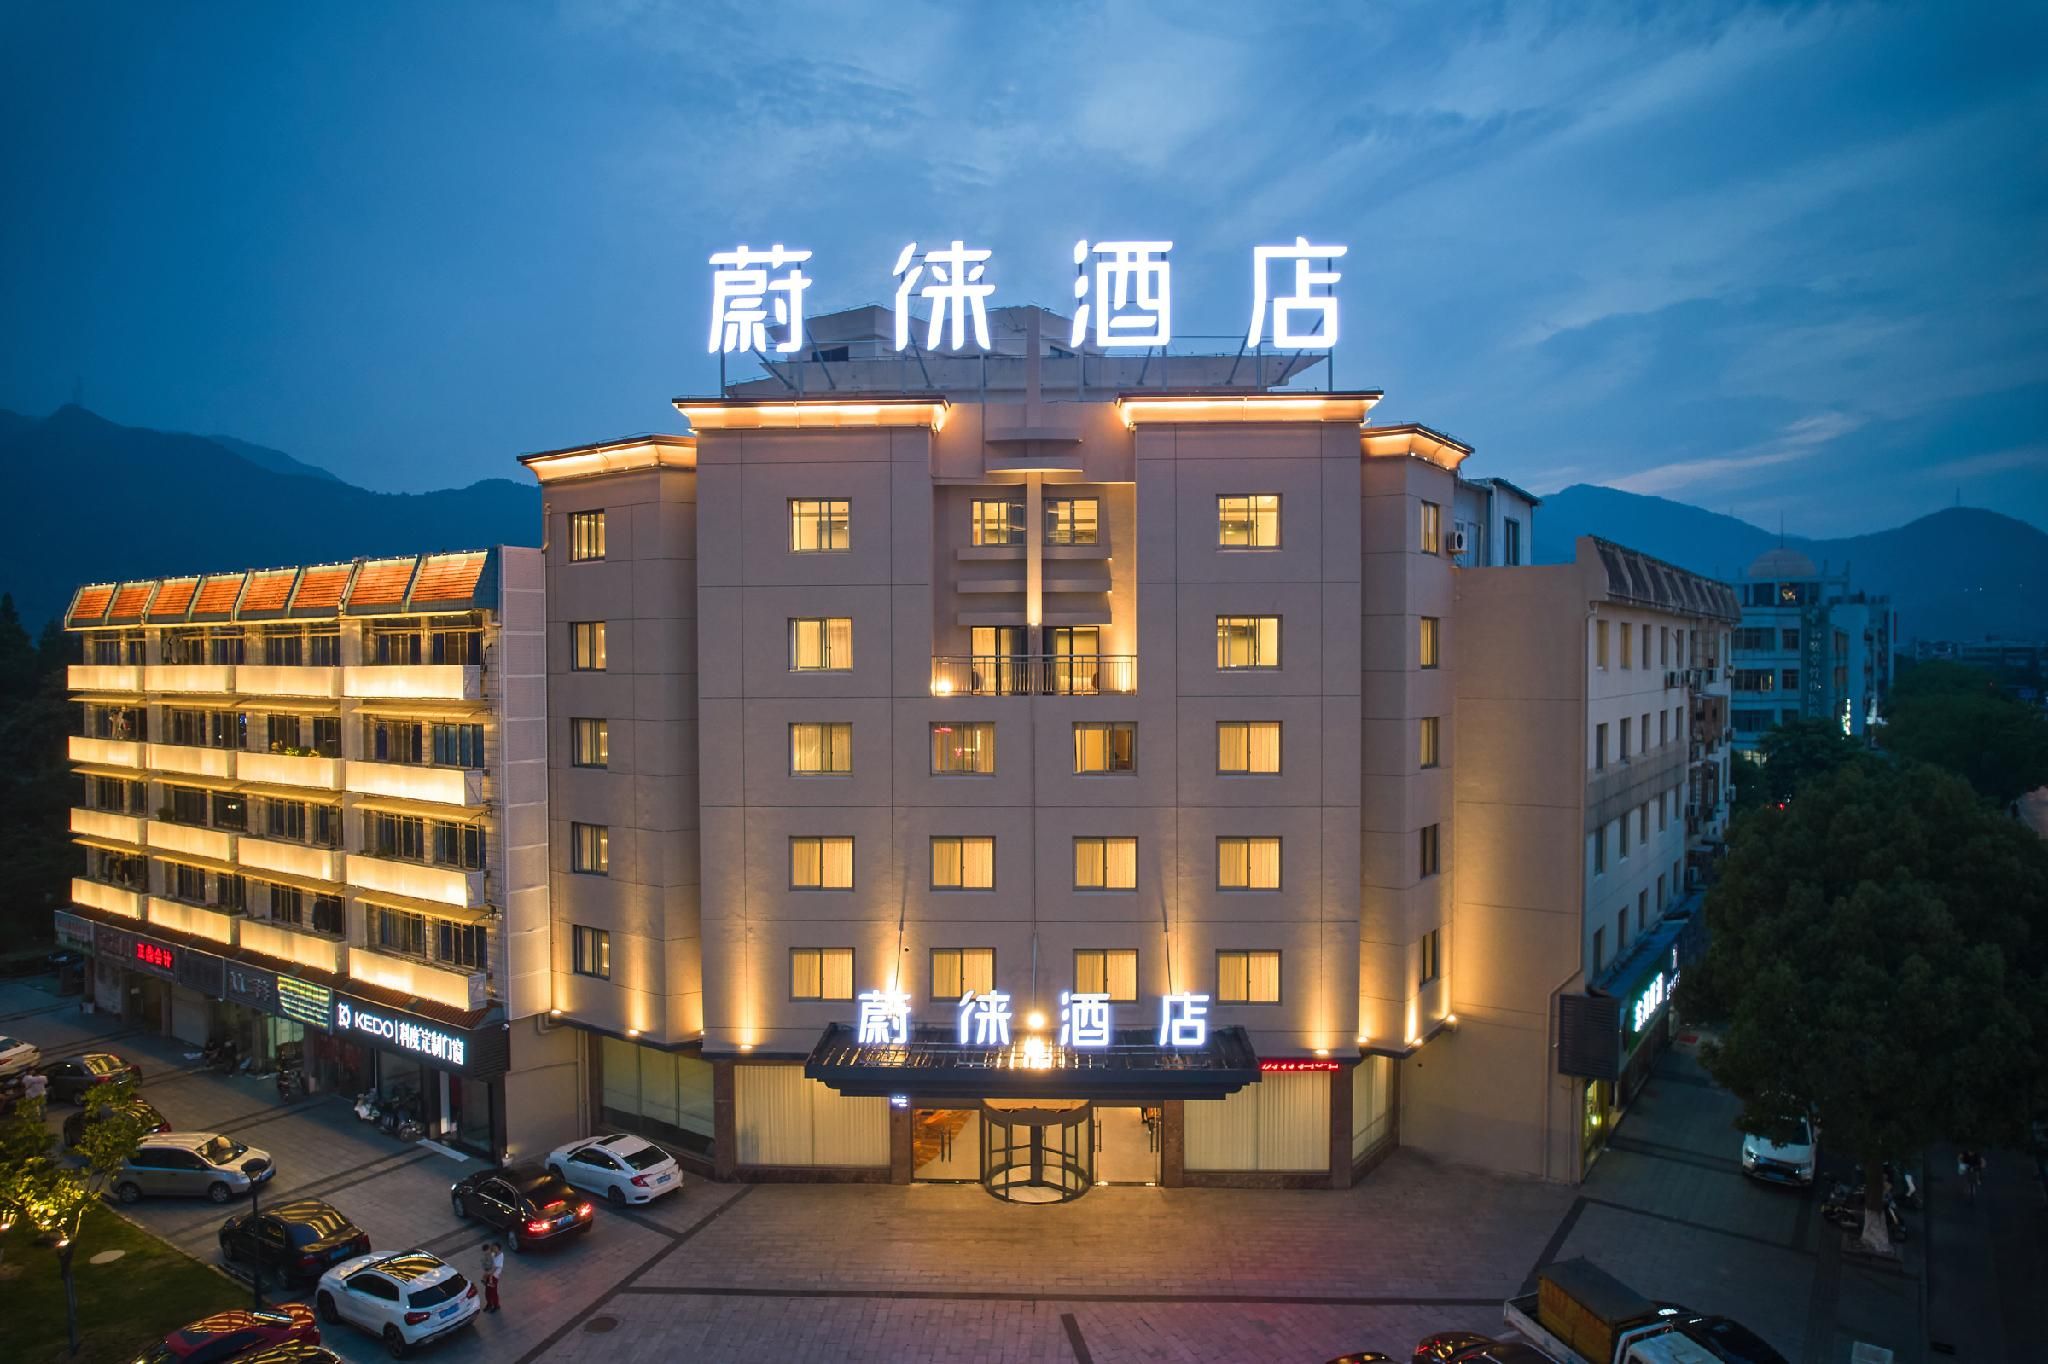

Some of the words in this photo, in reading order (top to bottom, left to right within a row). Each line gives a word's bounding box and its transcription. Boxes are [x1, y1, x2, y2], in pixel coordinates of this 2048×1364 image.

[708, 236, 1348, 353] 蔚徕酒店
[354, 1011, 394, 1039] KEDO
[399, 1022, 464, 1066] 科度定制门窗
[857, 990, 1210, 1048] 蔚徕酒店
